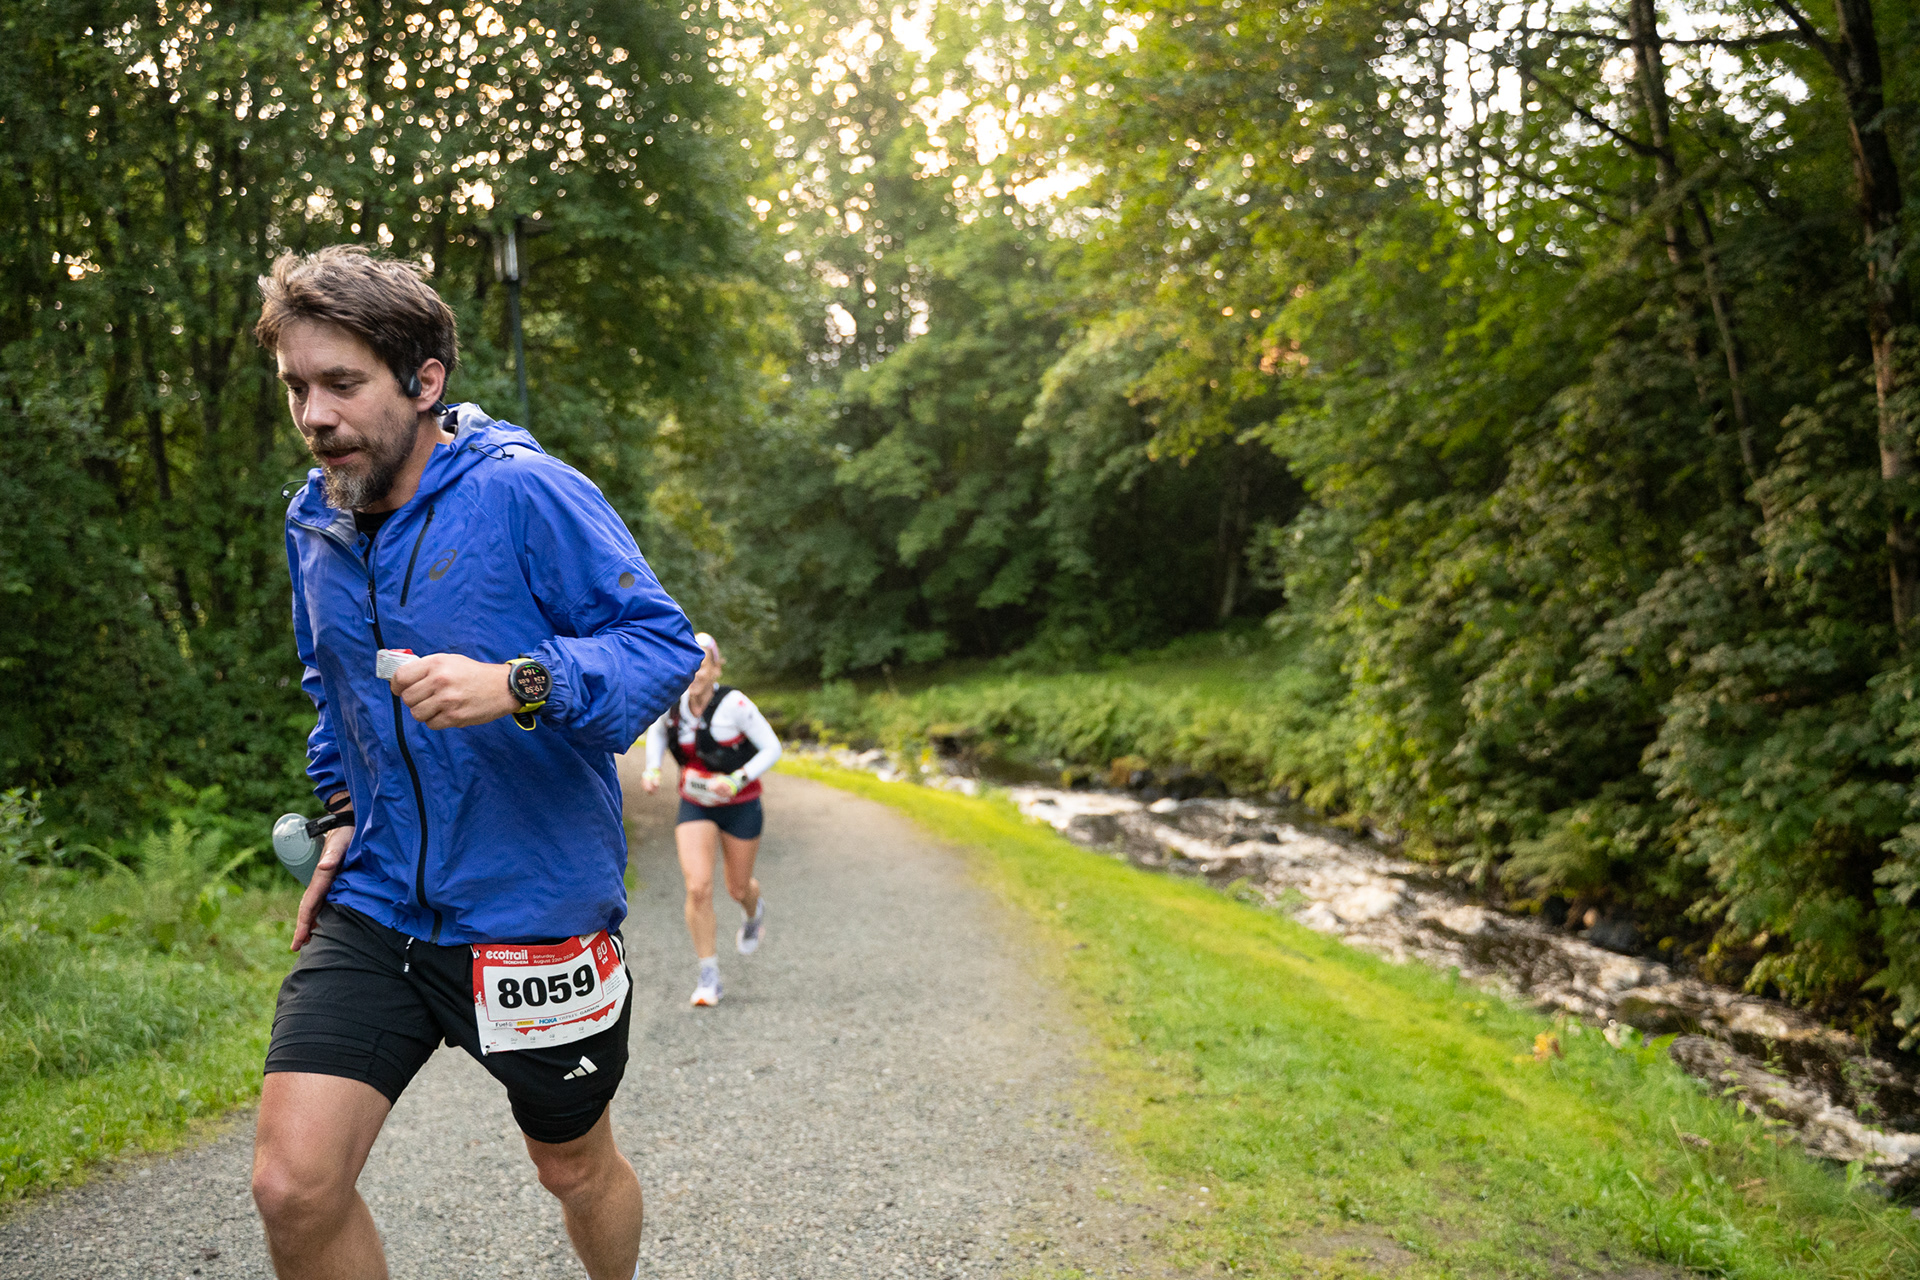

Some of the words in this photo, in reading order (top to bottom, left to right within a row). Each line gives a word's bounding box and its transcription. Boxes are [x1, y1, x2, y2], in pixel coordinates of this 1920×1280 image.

[485, 949, 528, 960] ecotrail
[601, 956, 609, 965] KM
[497, 964, 595, 1009] 8059
